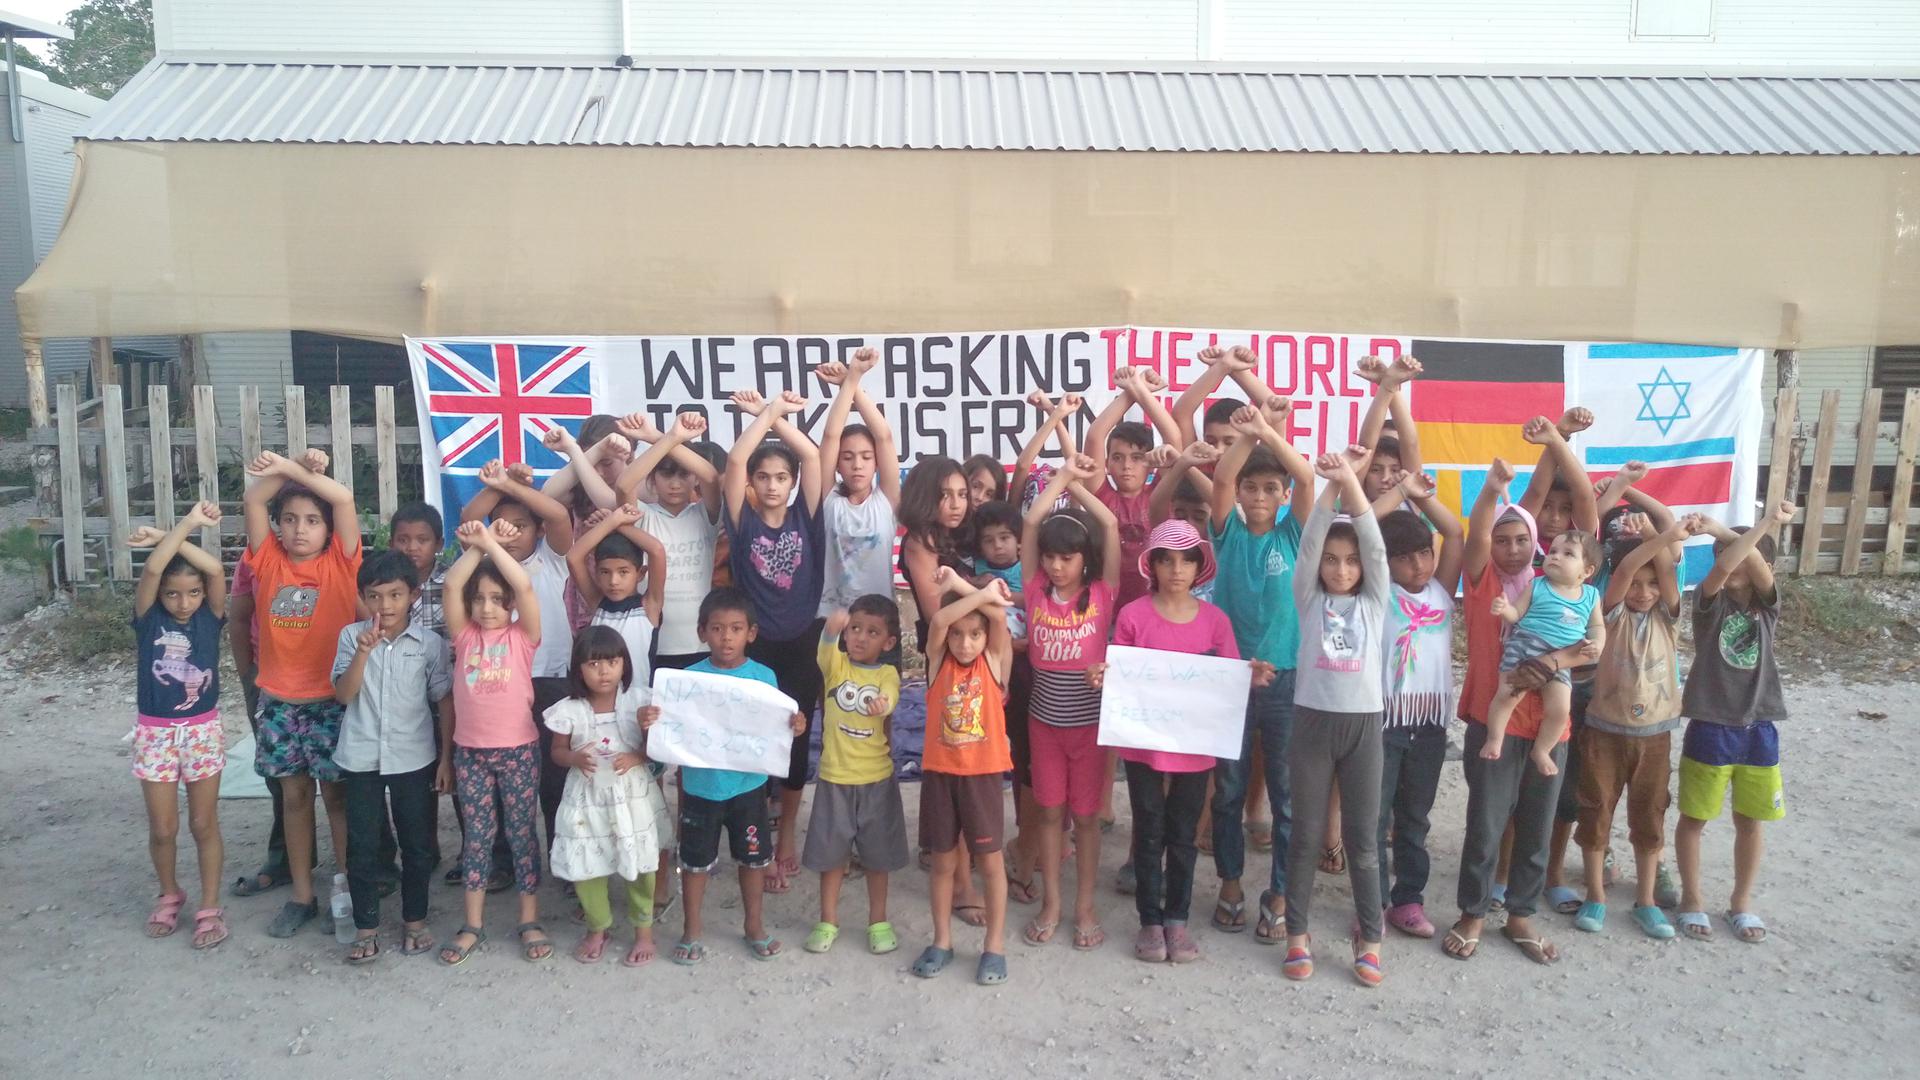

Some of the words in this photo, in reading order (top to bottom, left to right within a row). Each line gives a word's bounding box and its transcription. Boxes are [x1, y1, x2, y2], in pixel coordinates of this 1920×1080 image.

[641, 337, 736, 400] WE
[884, 331, 1091, 399] ASKING
[1100, 328, 1193, 392] THE
[1041, 641, 1082, 662] 10th
[1116, 658, 1159, 681] WE
